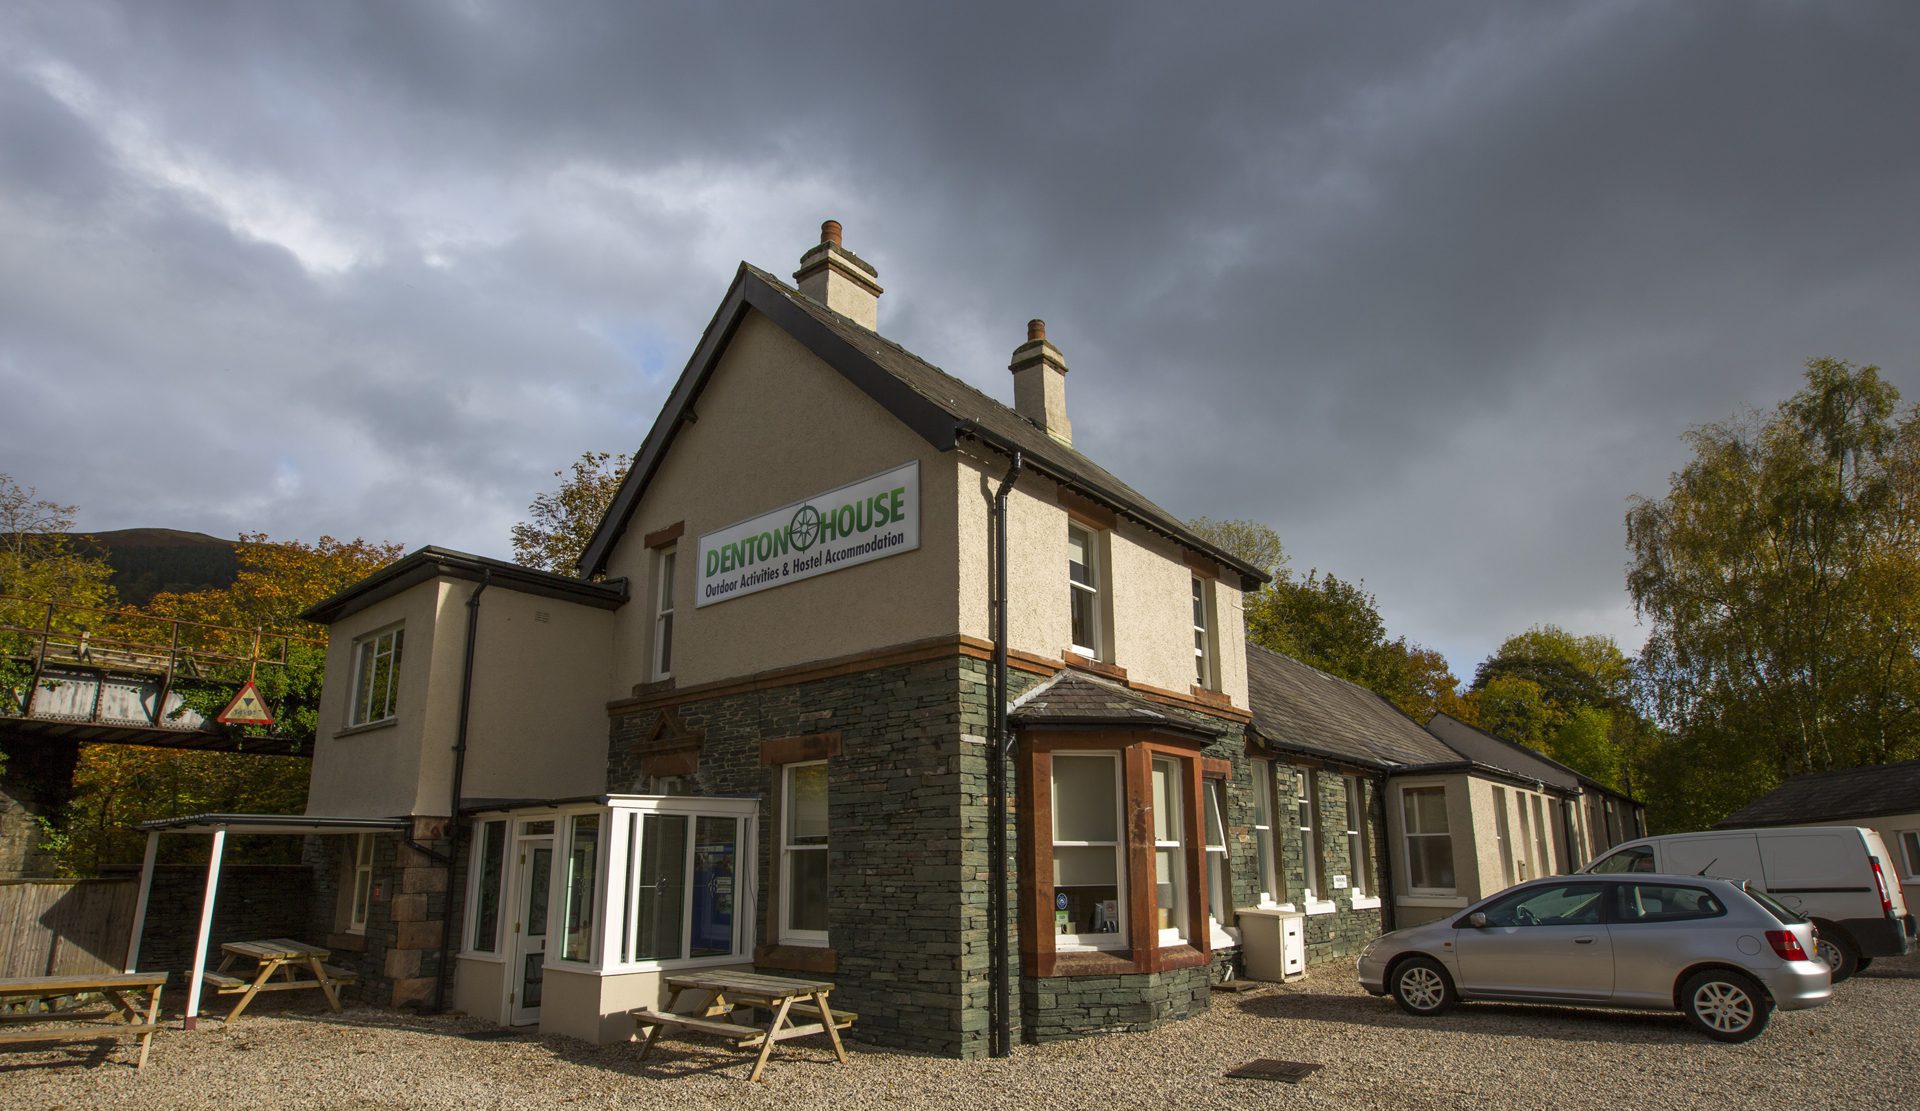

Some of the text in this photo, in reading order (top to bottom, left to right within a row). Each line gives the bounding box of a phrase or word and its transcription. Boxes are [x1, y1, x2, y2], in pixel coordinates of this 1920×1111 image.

[705, 532, 904, 598] Outdoor Activities & Hostel Accommodation
[706, 486, 906, 578] DENTON HOUSE
